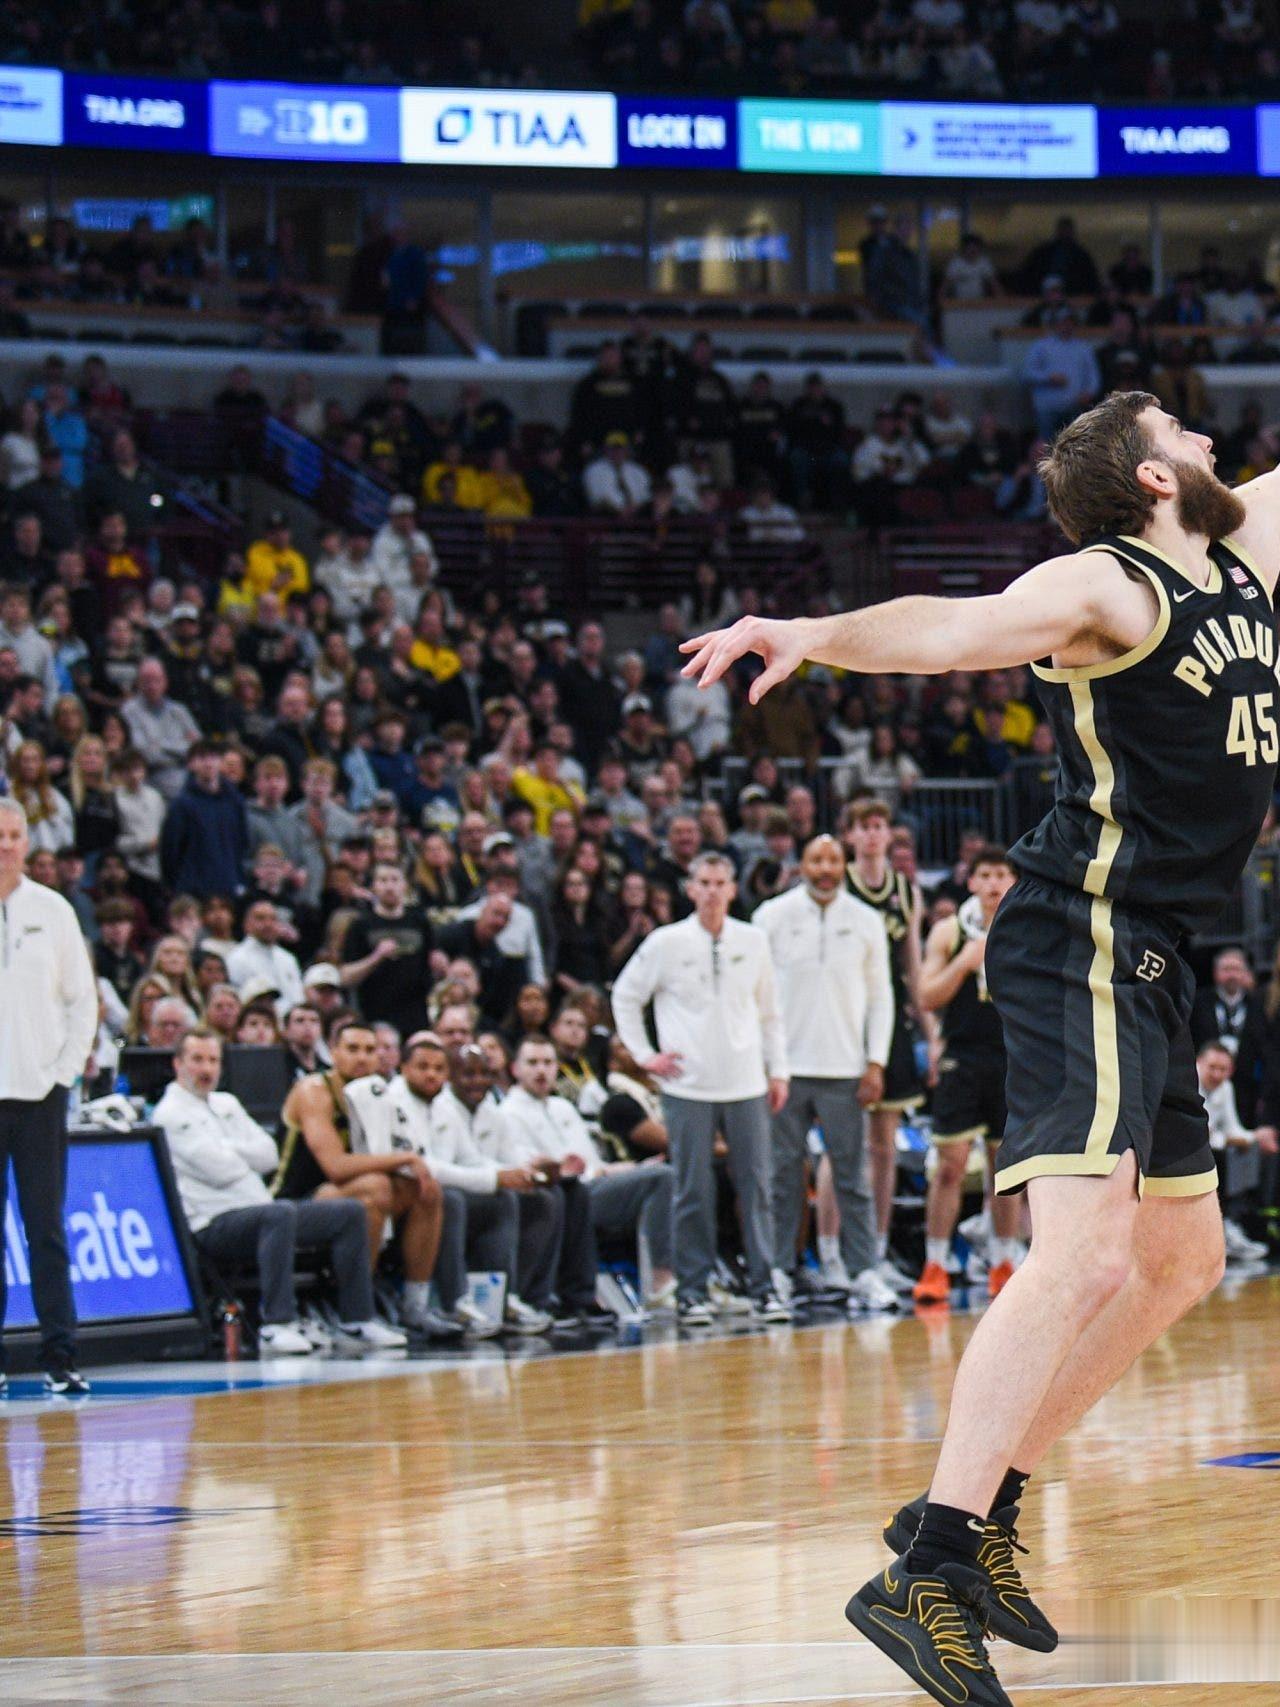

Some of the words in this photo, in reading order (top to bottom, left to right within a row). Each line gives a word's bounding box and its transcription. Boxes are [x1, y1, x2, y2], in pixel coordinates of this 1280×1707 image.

[485, 110, 587, 147] TIAA
[627, 113, 693, 148] LOCK
[694, 115, 726, 150] IN
[759, 118, 803, 151] THE
[805, 120, 863, 152] WIN
[1226, 692, 1280, 767] 45
[1135, 949, 1166, 983] P
